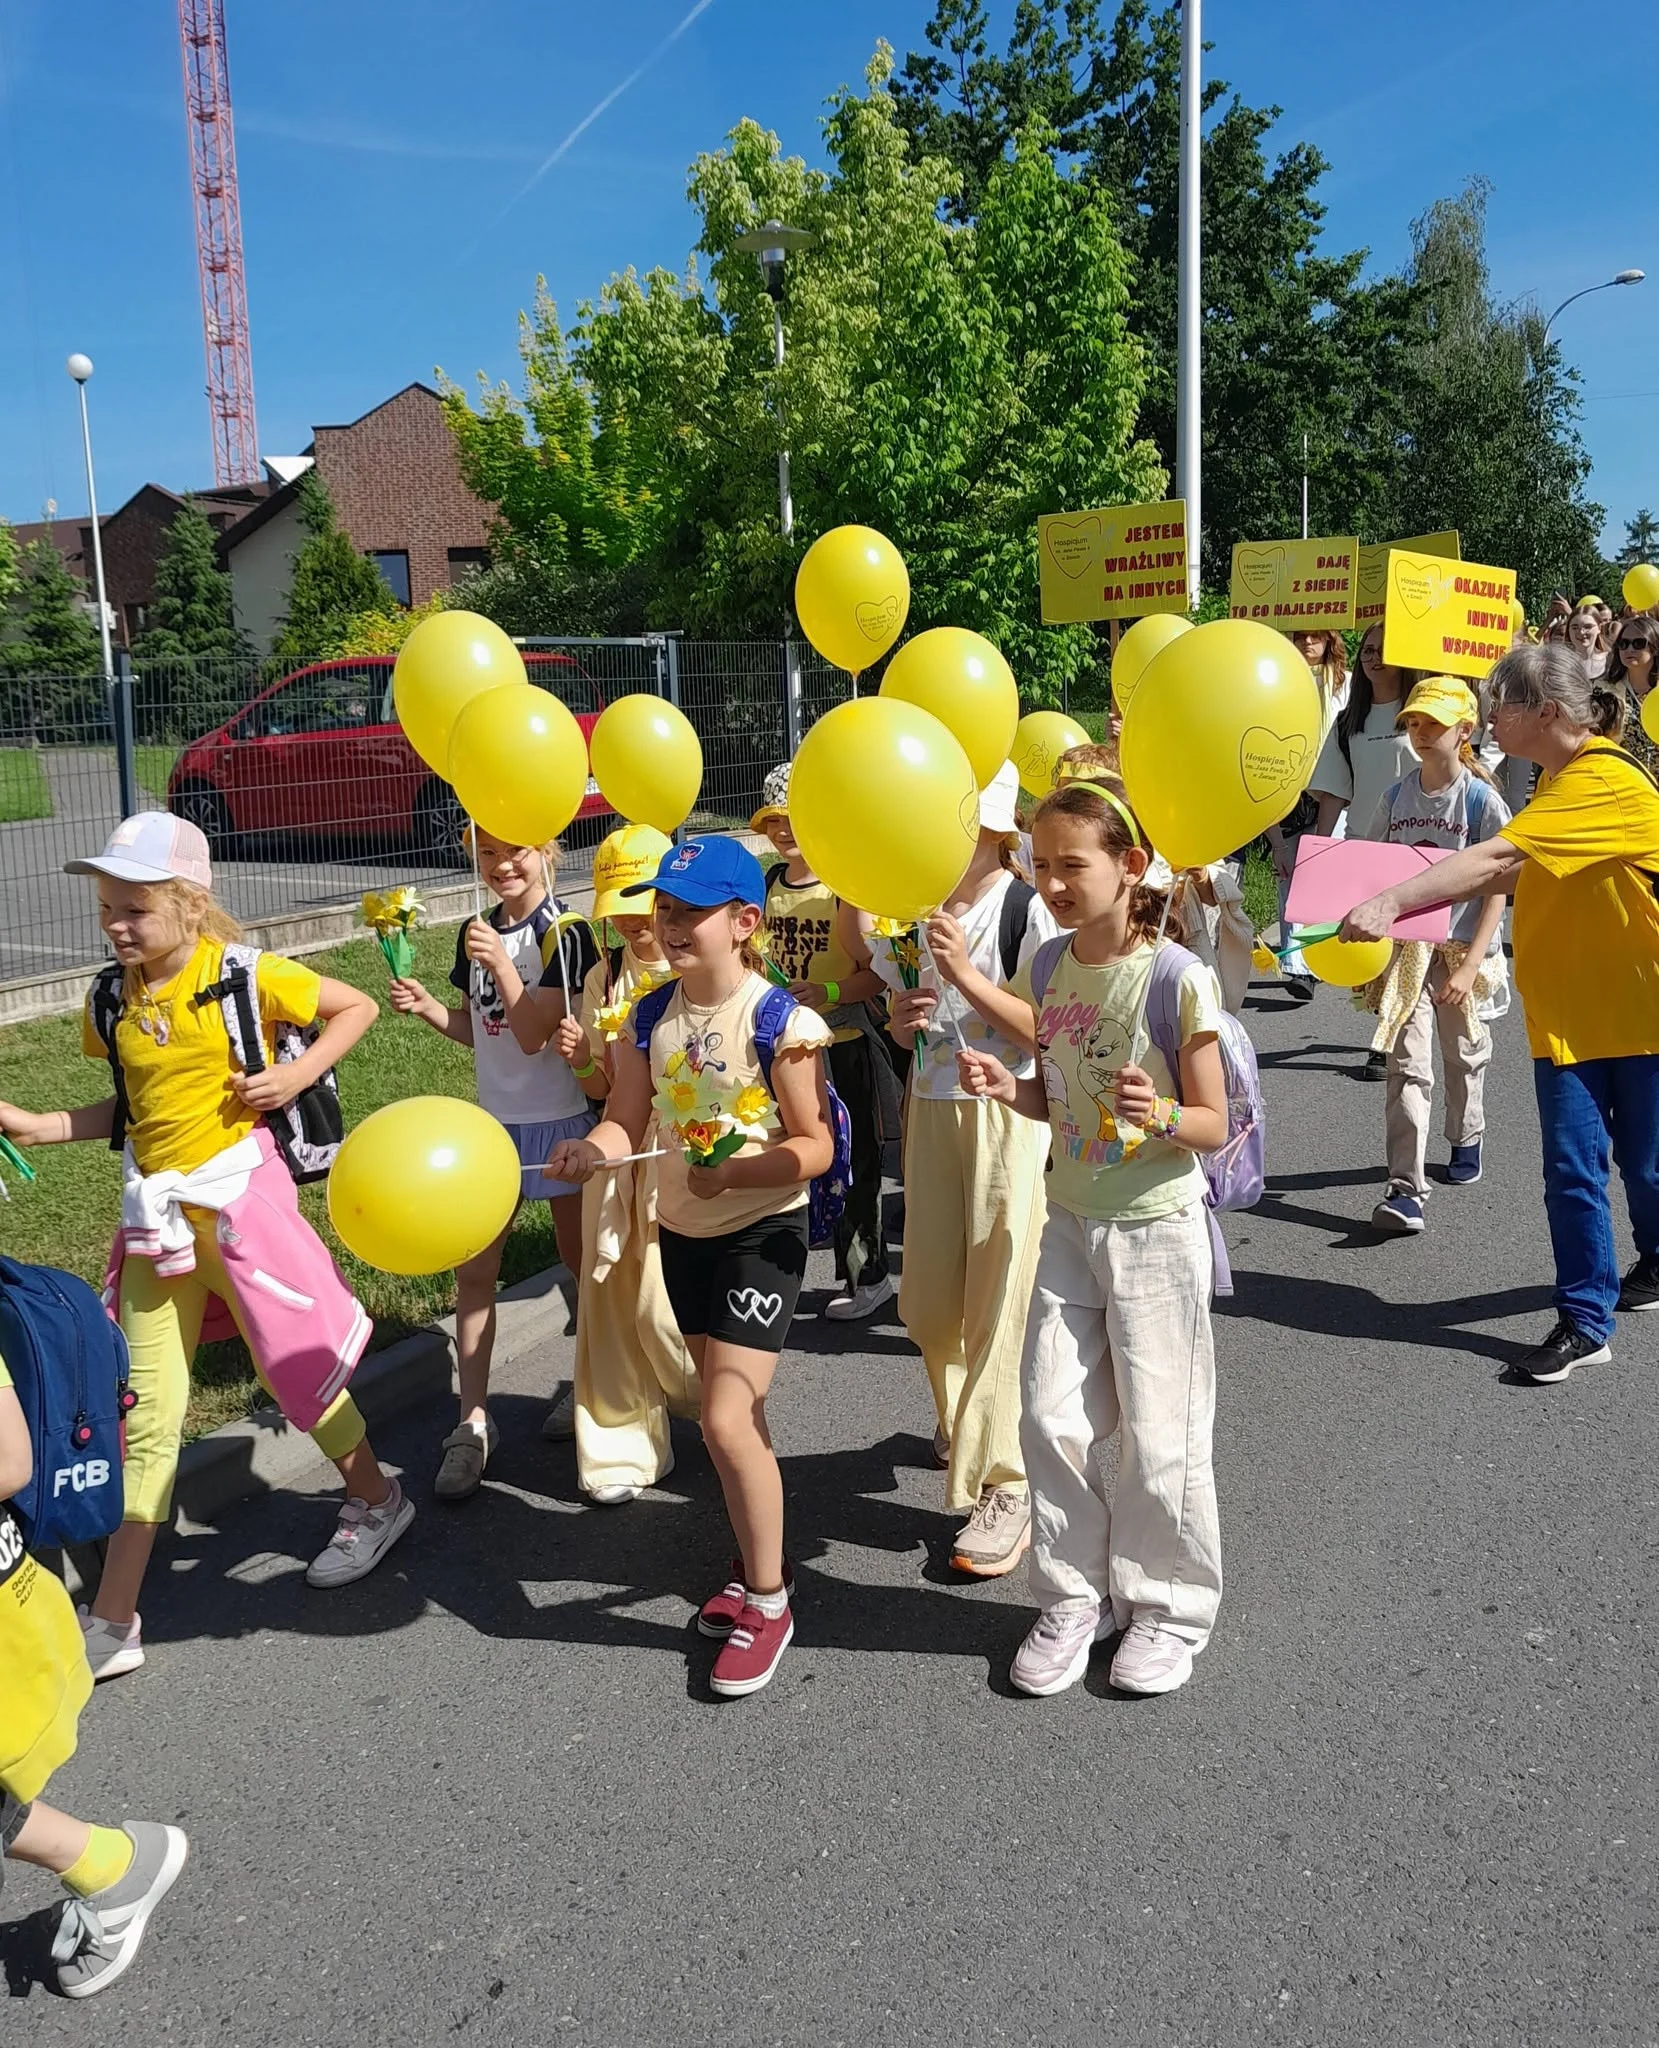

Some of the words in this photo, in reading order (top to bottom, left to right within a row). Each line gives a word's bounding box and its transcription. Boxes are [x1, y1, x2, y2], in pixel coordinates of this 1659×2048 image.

[1125, 522, 1184, 543] JESTEM
[1316, 555, 1350, 570] DAJĘ
[1104, 585, 1123, 601] NA
[1129, 579, 1185, 599] INNYCH
[1292, 580, 1300, 593] Z
[1304, 578, 1349, 592] SIEBIE
[1454, 576, 1510, 604] OKAZUJĘ
[1231, 605, 1248, 619] TO
[1252, 604, 1269, 618] CO
[1273, 601, 1347, 617] NAJLEPSZE
[1467, 610, 1508, 631] INNYM
[1063, 1134, 1126, 1164] THING
[53, 1459, 110, 1498] FCB
